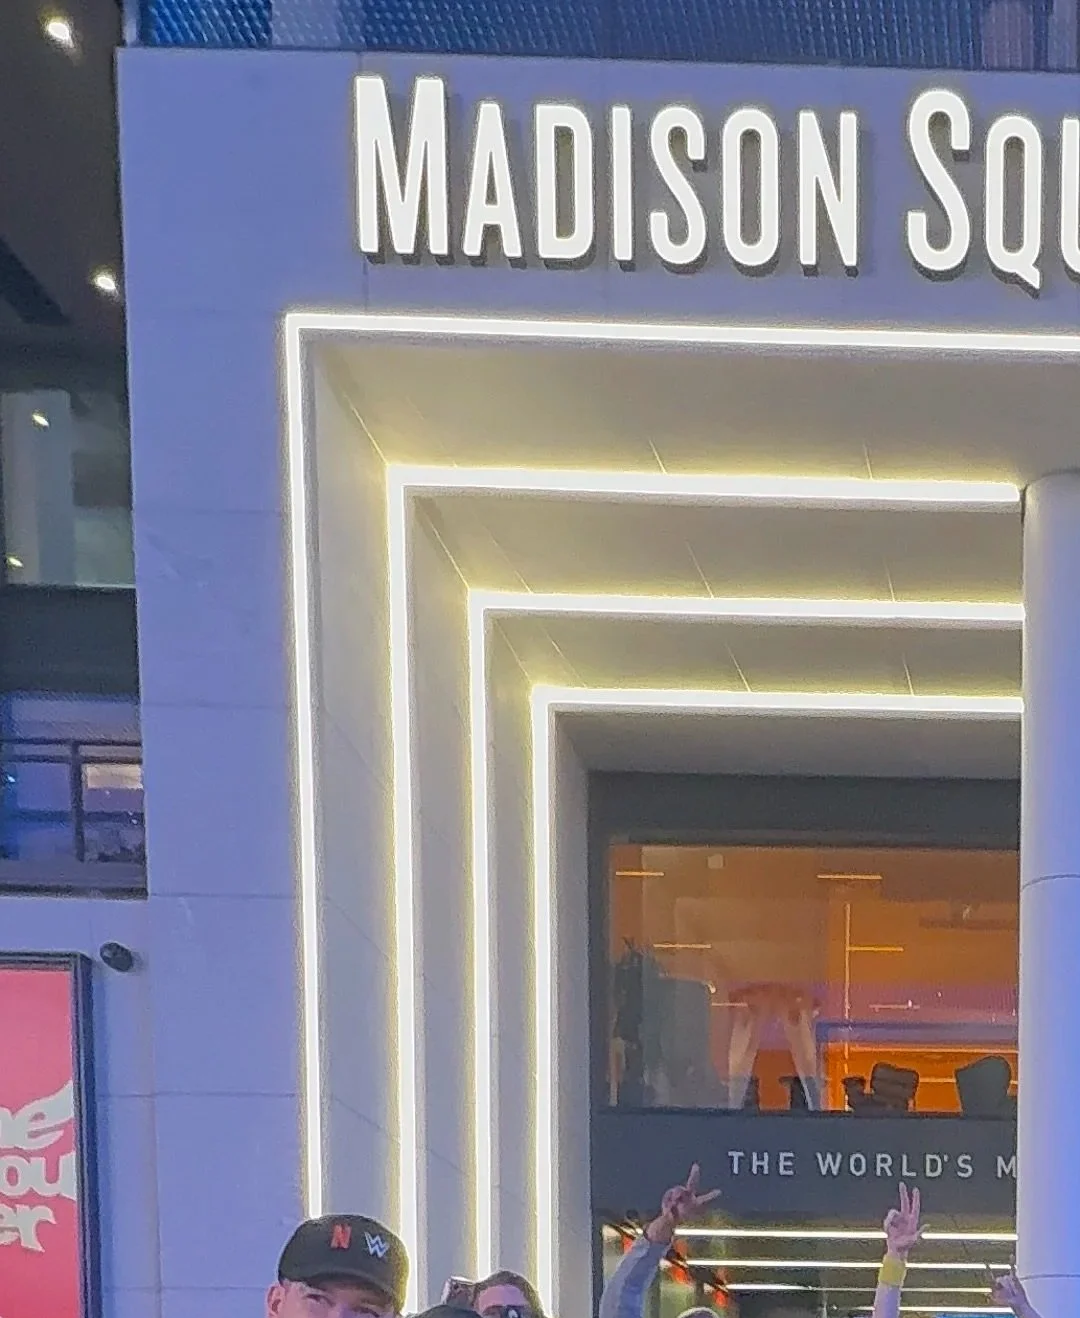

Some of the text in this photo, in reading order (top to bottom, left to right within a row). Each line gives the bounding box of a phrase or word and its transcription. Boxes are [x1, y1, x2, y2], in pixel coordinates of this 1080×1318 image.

[354, 76, 858, 266] MADISON
[728, 1151, 795, 1176] THE
[816, 1152, 973, 1178] WORLD'S
